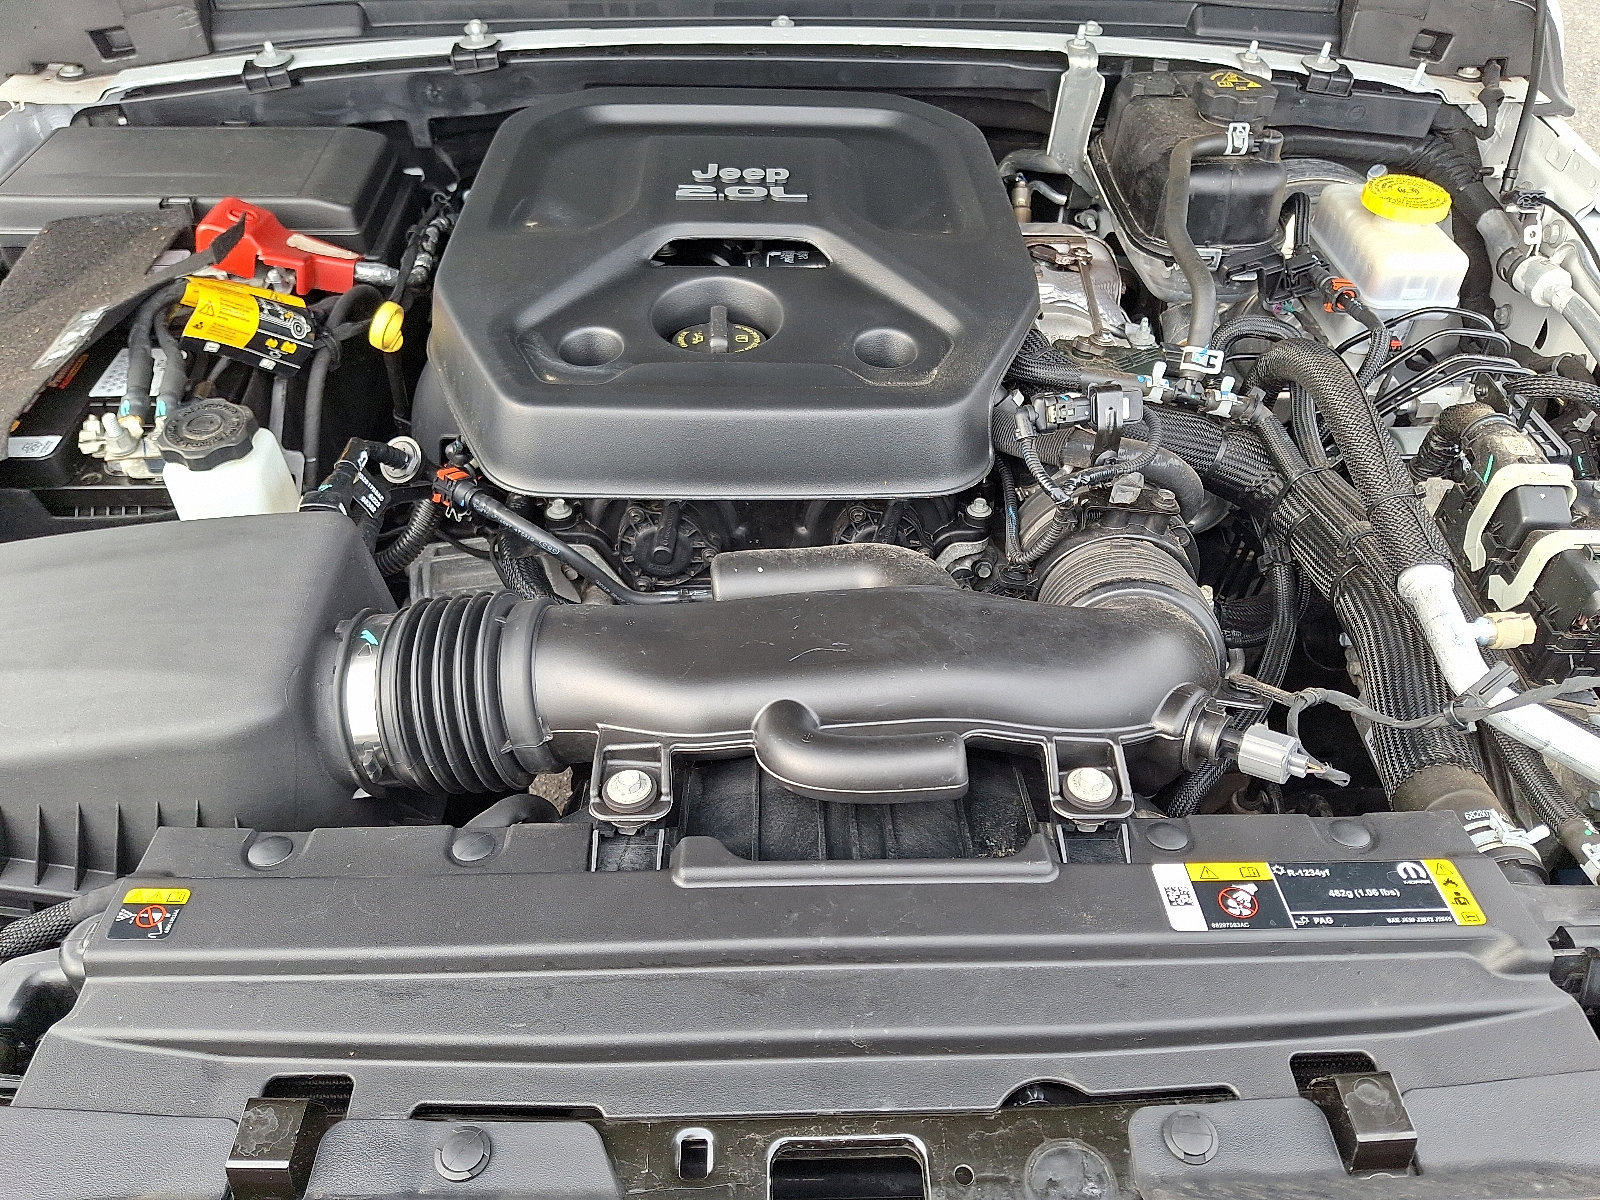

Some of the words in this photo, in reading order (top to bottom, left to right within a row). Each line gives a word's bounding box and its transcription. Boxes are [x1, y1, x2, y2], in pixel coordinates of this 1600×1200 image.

[691, 163, 790, 186] Jeep
[675, 184, 808, 203] 2.0L
[1286, 868, 1331, 878] R-1234yf
[1380, 887, 1401, 898] lbs)
[1312, 916, 1334, 925] PAG
